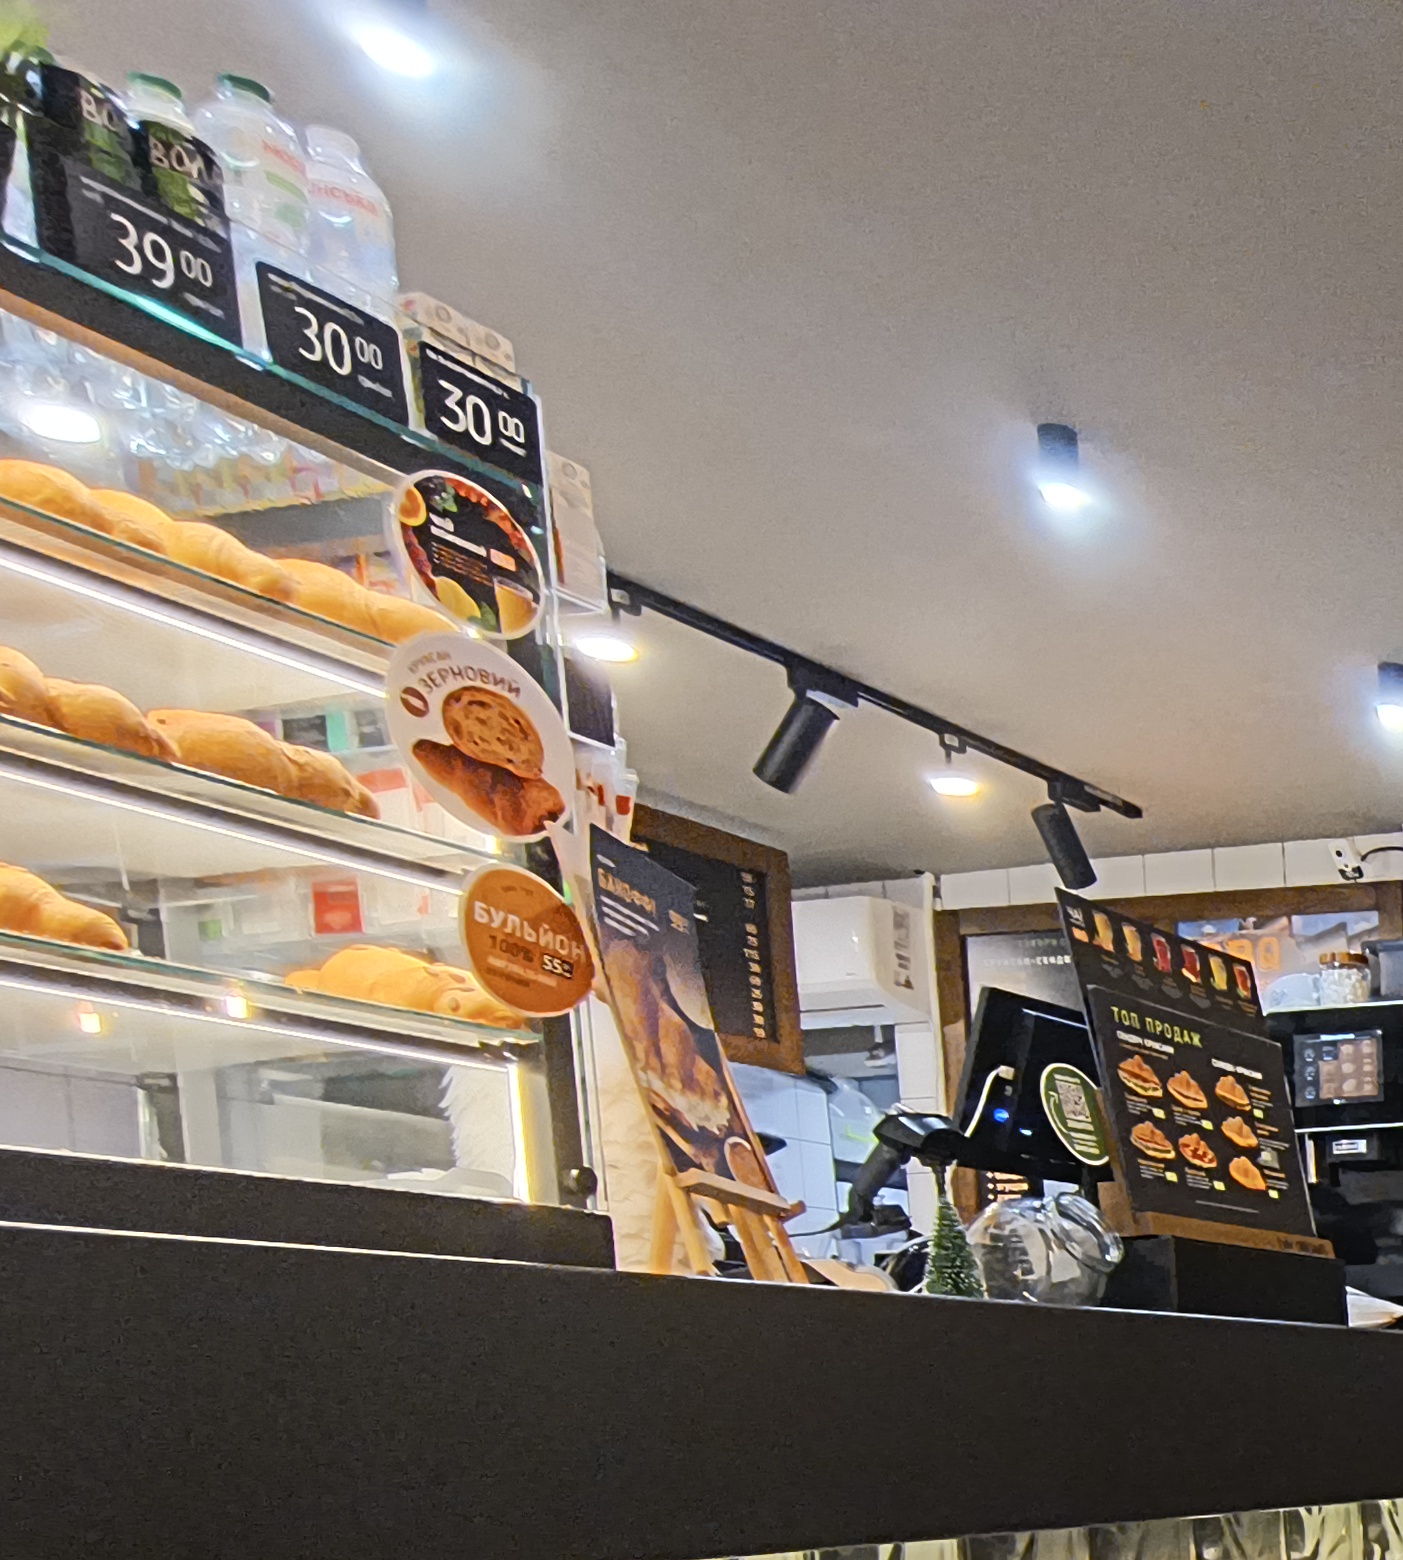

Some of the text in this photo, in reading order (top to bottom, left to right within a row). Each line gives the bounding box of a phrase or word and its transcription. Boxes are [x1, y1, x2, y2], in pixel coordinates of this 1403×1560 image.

[107, 211, 176, 290] 39
[179, 250, 213, 288] 00
[294, 306, 383, 376] 30 00
[436, 378, 493, 446] 30
[497, 410, 526, 443] 00
[418, 665, 521, 699] ЗЕРНОВИЙ
[473, 900, 588, 965] БУЛЬЙОН
[1110, 1006, 1141, 1030] ТОП
[1145, 1016, 1203, 1049] ПРОДАЖ
